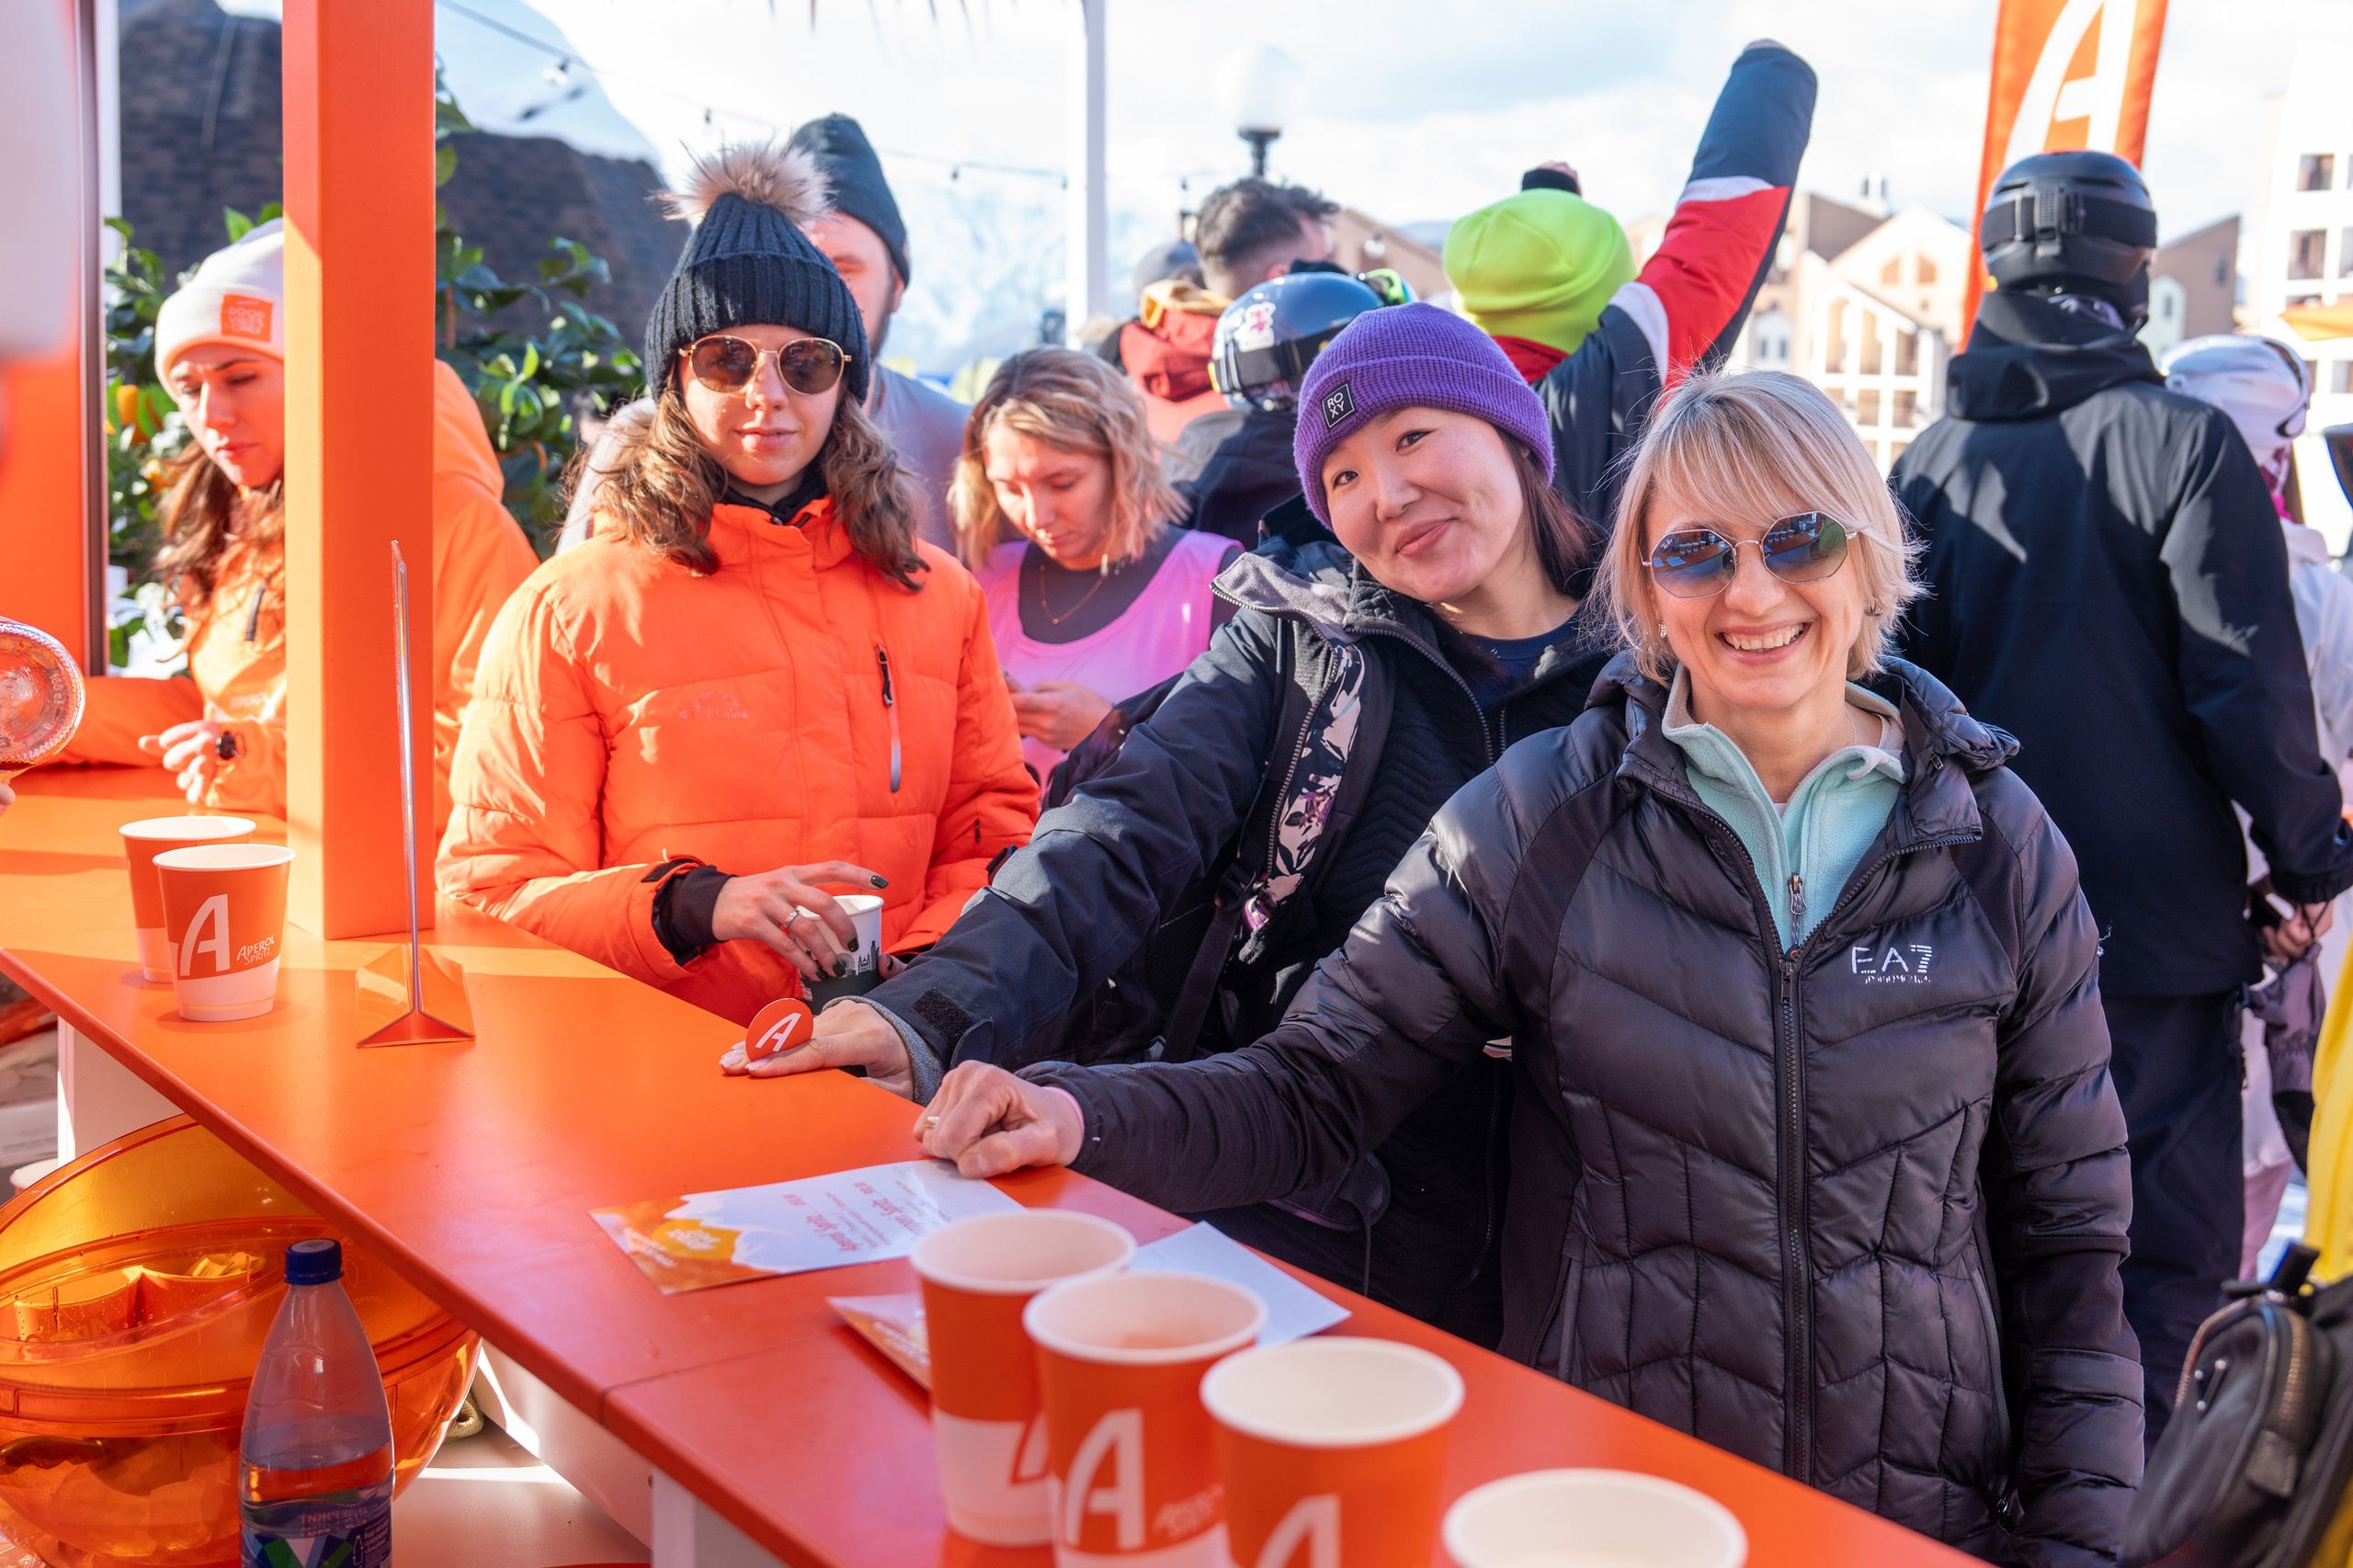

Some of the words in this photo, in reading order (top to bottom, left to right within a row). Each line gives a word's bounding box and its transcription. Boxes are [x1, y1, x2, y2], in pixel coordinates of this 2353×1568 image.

[2002, 0, 2138, 168] A
[179, 893, 231, 976] A
[236, 934, 276, 961] APEROL
[244, 947, 271, 965] SPRITZ
[1851, 944, 1932, 973] EA7
[755, 1012, 801, 1052] A
[1064, 1407, 1145, 1551] A
